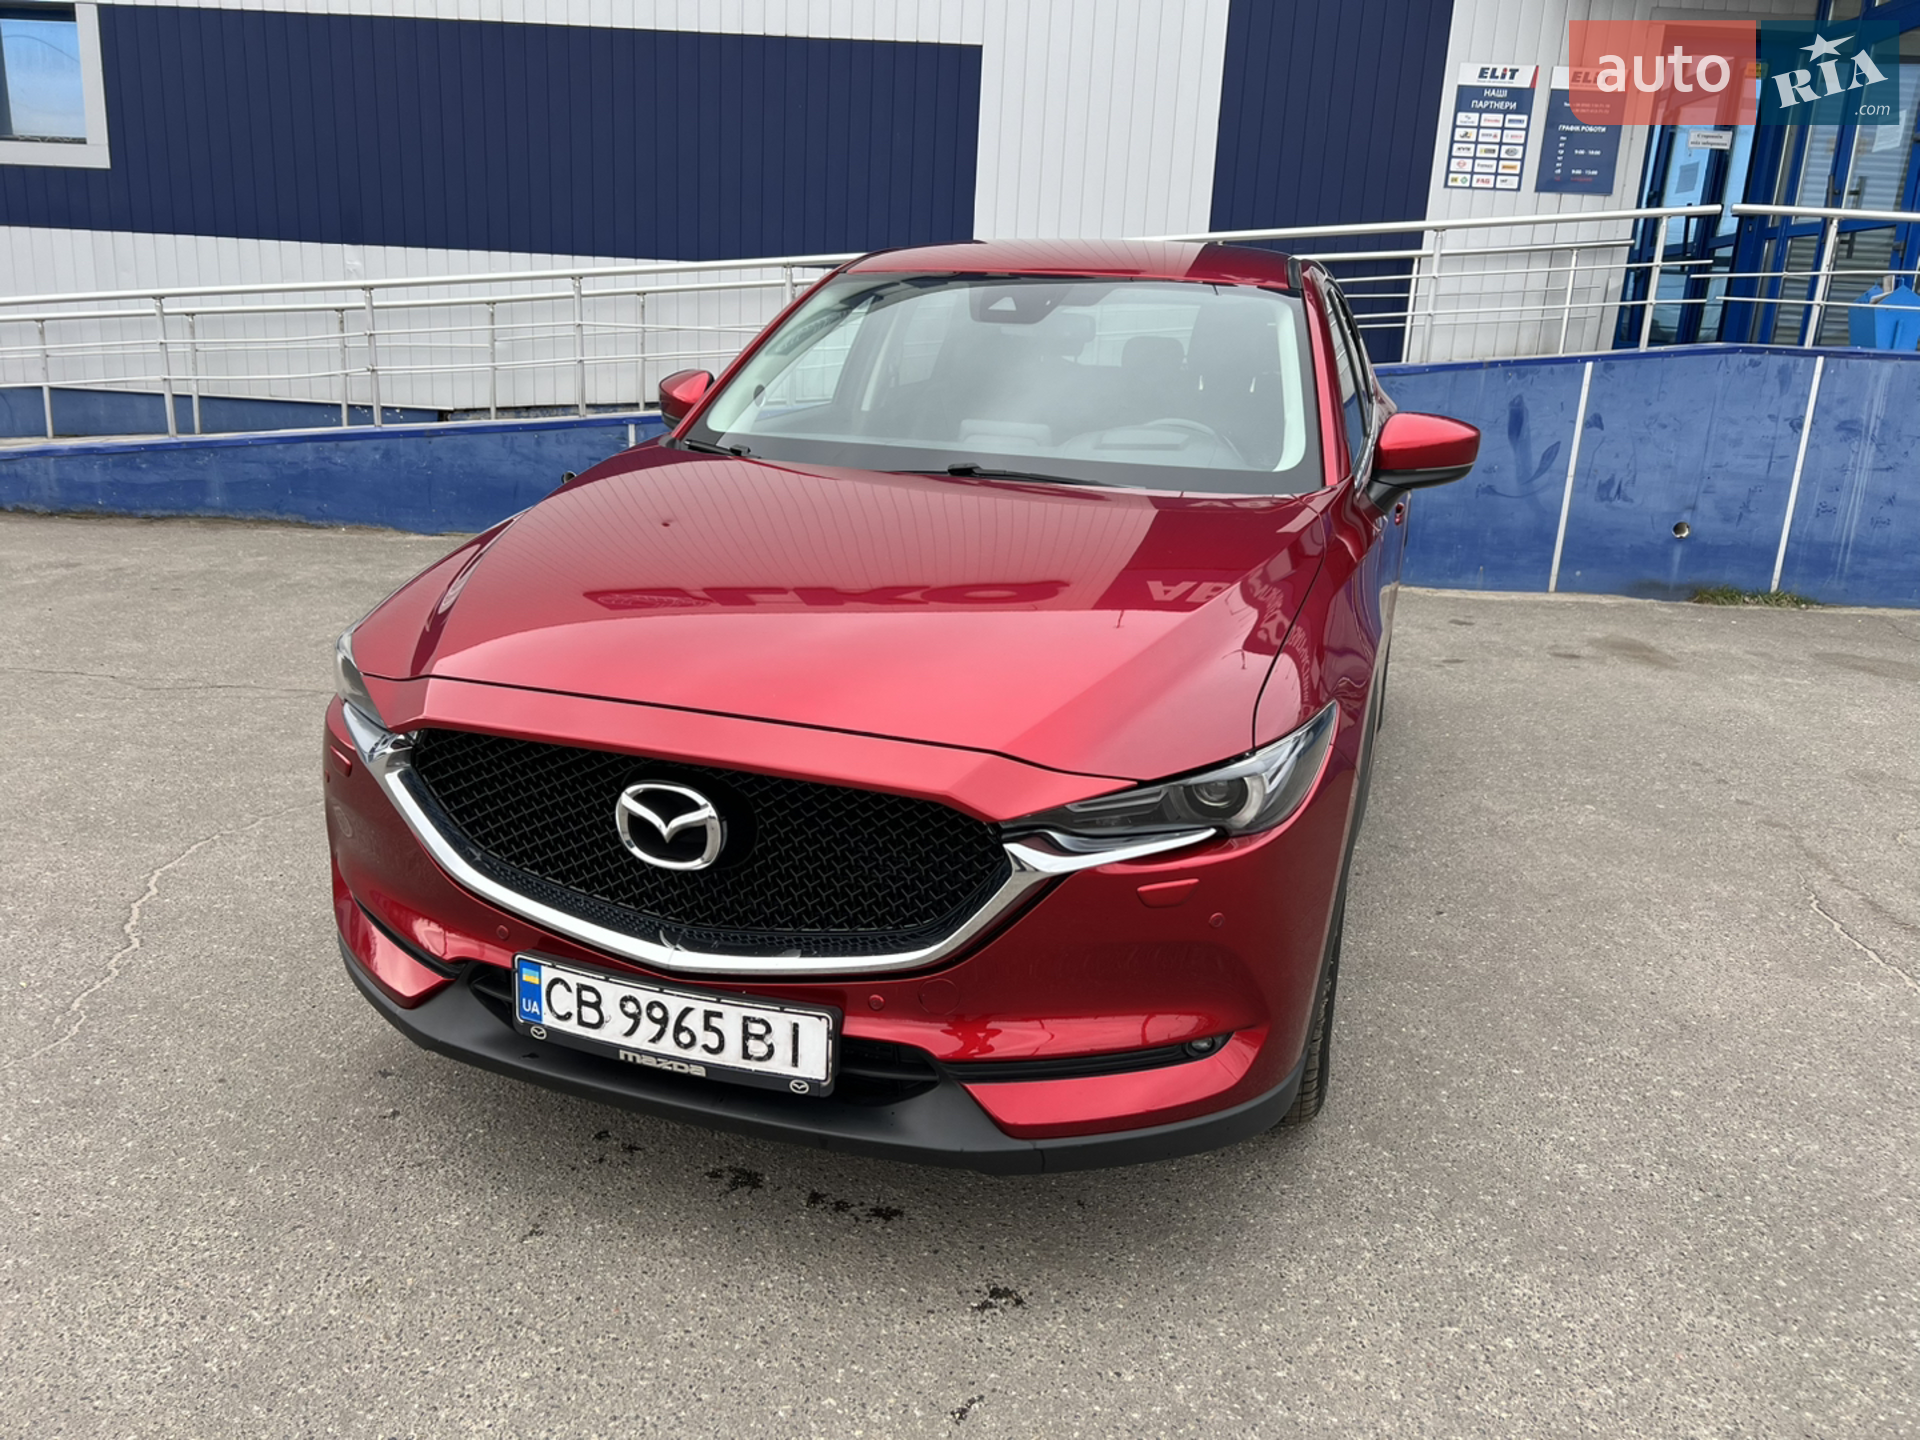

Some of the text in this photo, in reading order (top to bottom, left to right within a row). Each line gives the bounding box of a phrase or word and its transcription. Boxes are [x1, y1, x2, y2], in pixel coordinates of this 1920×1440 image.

[1484, 88, 1508, 98] НАШІ
[1471, 99, 1518, 110] ПАРТНЕРИ
[1581, 125, 1607, 133] РОБОТИ
[522, 997, 541, 1016] UA
[545, 976, 799, 1068] CB 9965 BI
[619, 1049, 706, 1078] mazda
